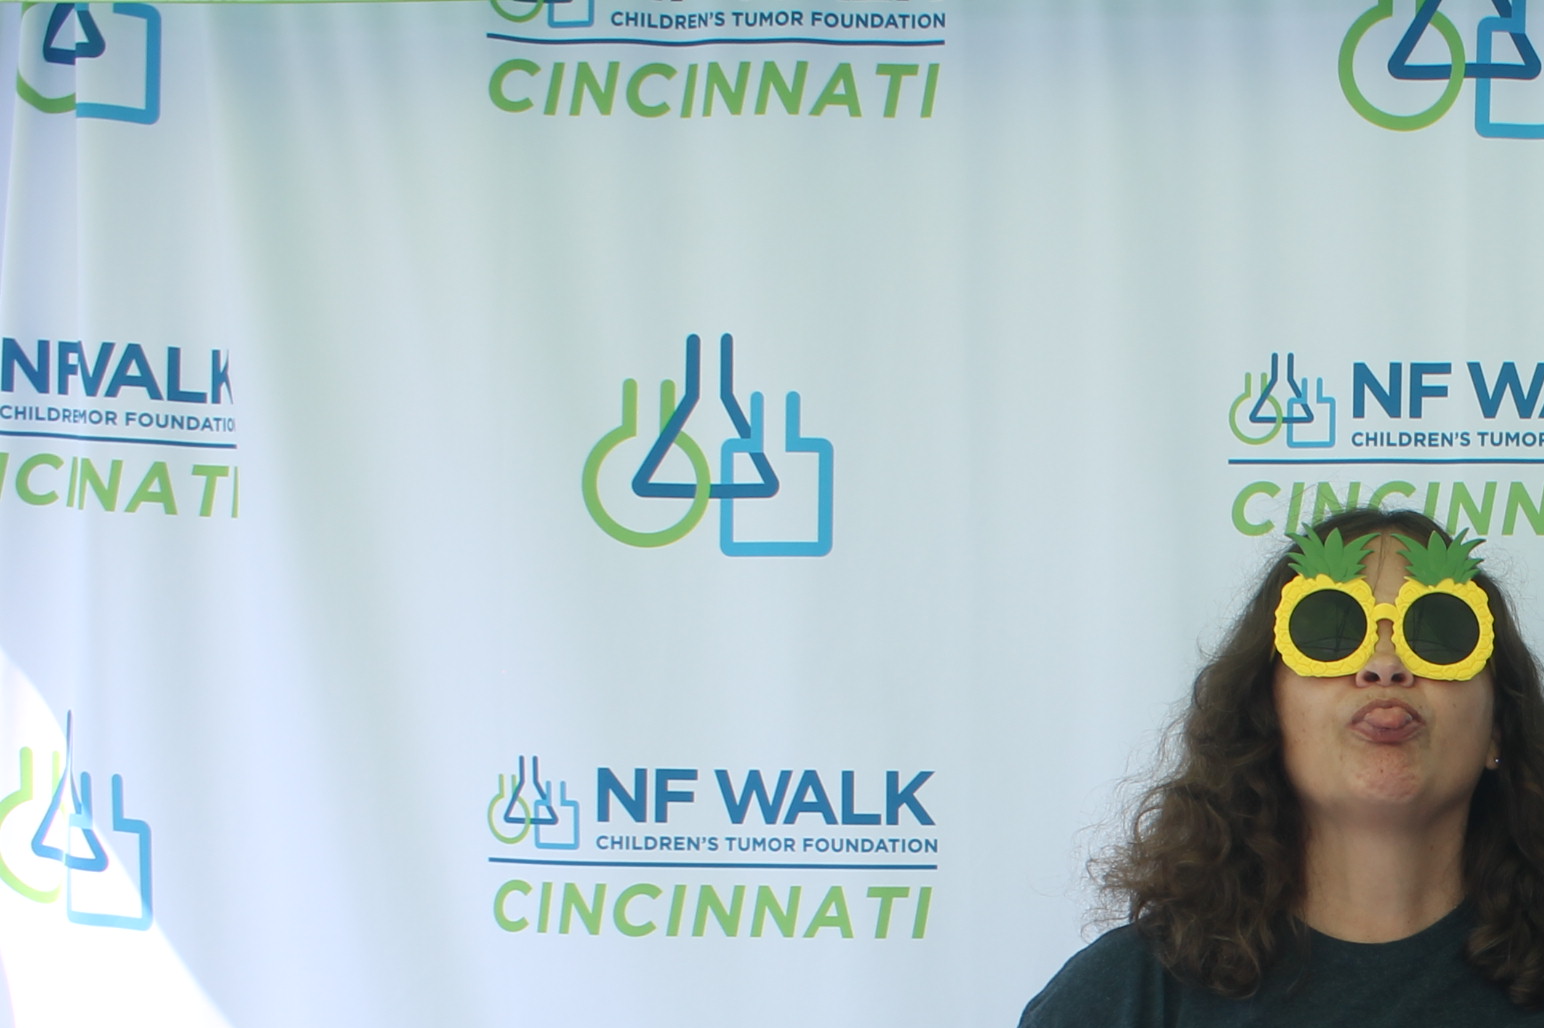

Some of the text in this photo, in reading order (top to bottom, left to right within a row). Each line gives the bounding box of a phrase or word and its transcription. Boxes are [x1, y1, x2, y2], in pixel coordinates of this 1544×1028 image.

[610, 11, 946, 30] CHILDREN'S TUMOR FOUNDATION
[488, 58, 940, 118] CINCINNATI
[1352, 362, 1452, 419] NF
[125, 411, 236, 432] FOUNDATIO
[1351, 431, 1471, 447] CHILDREN'S
[597, 767, 936, 826] NF WALK
[596, 835, 938, 854] CHILDREN'S TUMOR FOUNDATION
[493, 879, 933, 939] CINCINNATI
